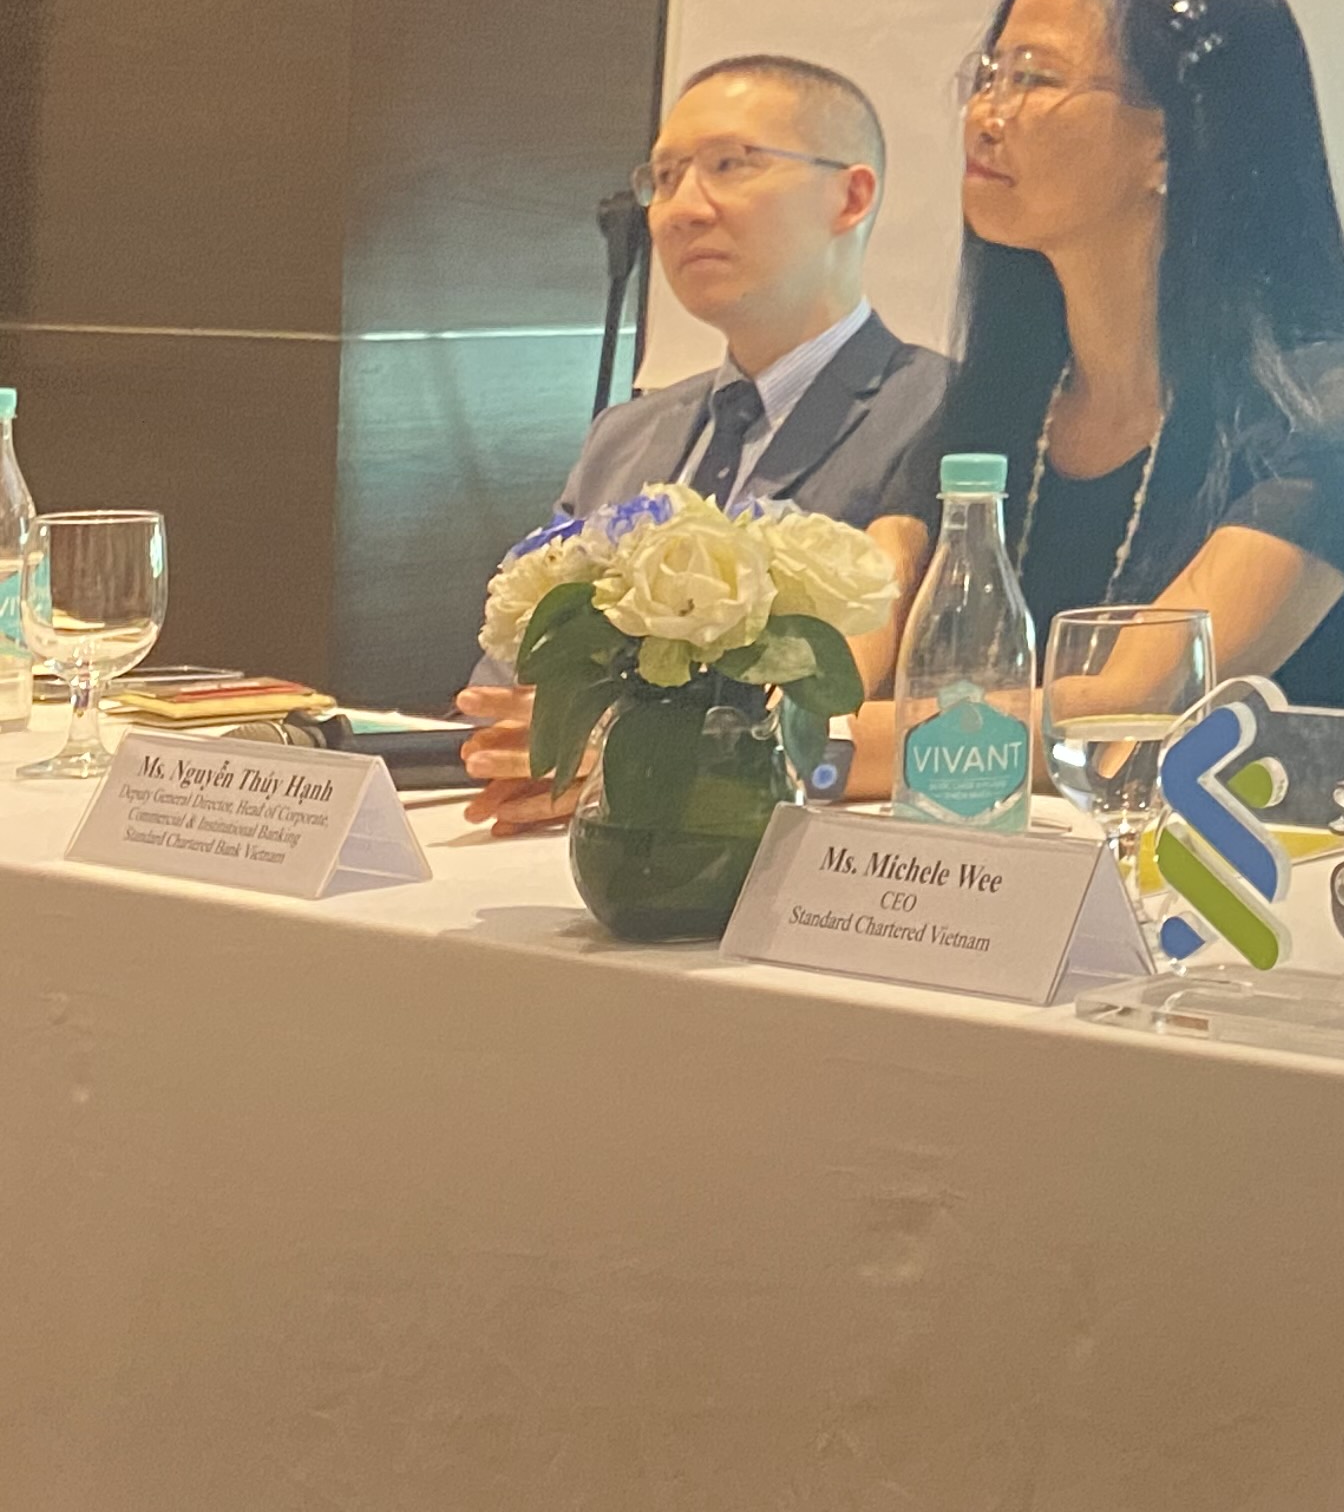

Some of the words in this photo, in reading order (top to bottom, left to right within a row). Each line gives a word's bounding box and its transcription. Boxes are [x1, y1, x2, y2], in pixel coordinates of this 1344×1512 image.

[913, 741, 1022, 773] VIVANT
[138, 755, 165, 779] Ms.
[169, 759, 234, 791] Nguyễn
[285, 775, 333, 805] Hạnh
[236, 800, 265, 817] Head
[819, 846, 857, 876] Ms.
[862, 851, 950, 887] Michele
[958, 863, 1003, 894] Wee
[880, 890, 917, 913] CEO
[789, 905, 854, 932] Standard
[855, 914, 927, 943] Chartered
[929, 924, 991, 952] Vietnam
